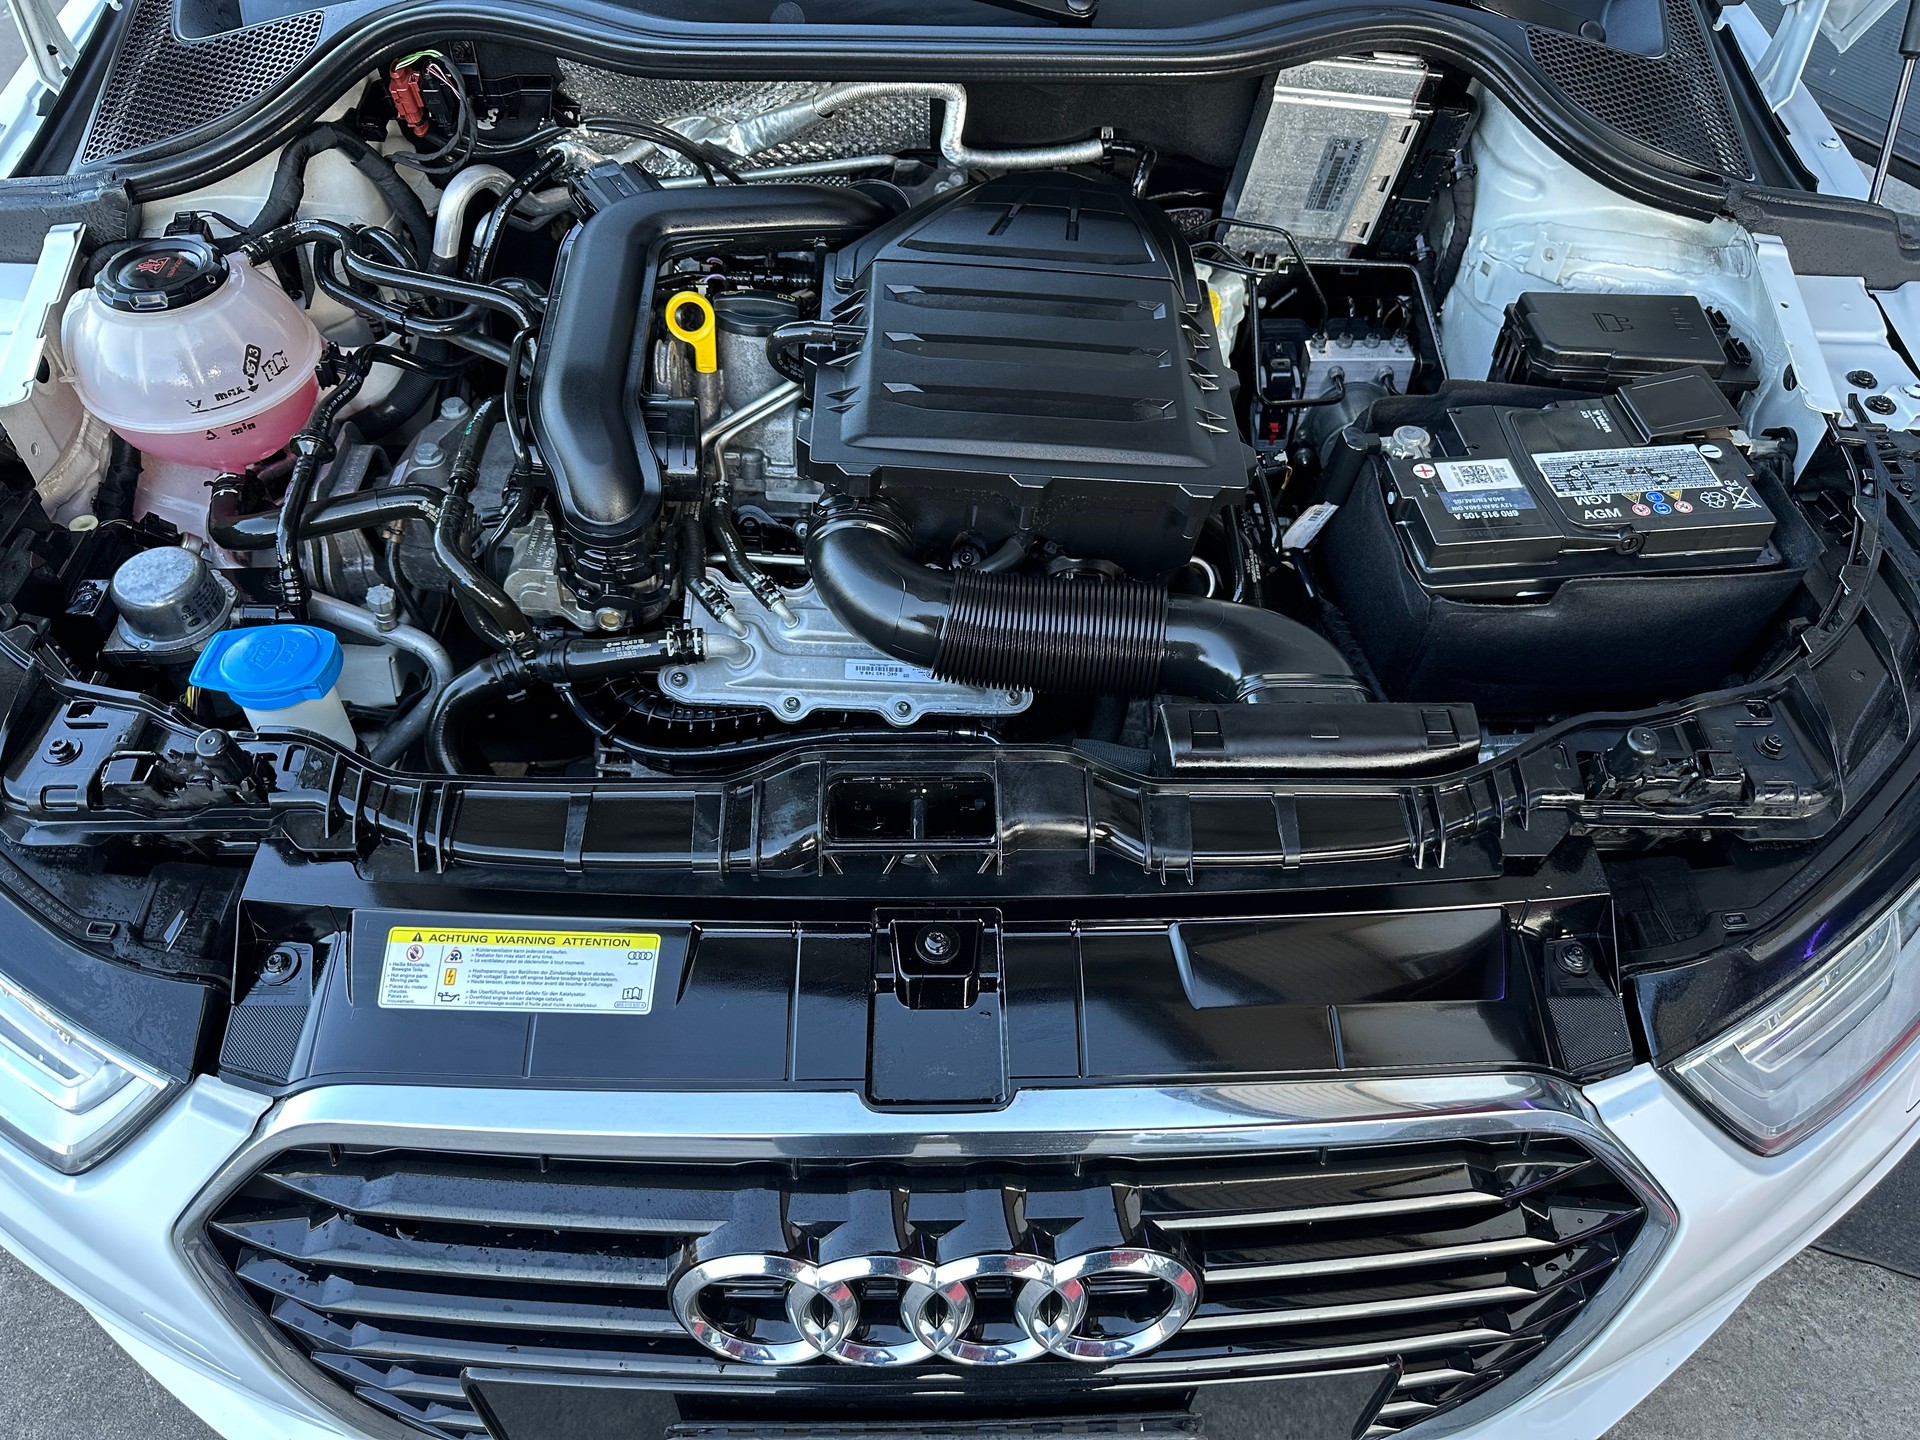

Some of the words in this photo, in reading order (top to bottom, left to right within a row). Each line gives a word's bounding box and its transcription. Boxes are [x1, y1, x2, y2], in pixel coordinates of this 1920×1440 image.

[1354, 140, 1363, 152] VW
[1349, 154, 1357, 165] AG
[214, 386, 245, 401] max
[231, 422, 256, 435] min
[1574, 495, 1611, 505] AGM
[1463, 512, 1480, 520] 105
[1501, 509, 1519, 517] 6R0
[1584, 508, 1622, 520] AGM
[428, 934, 488, 944] ACHTUNG
[495, 936, 556, 945] WARNING
[562, 937, 631, 947] ATTENTION
